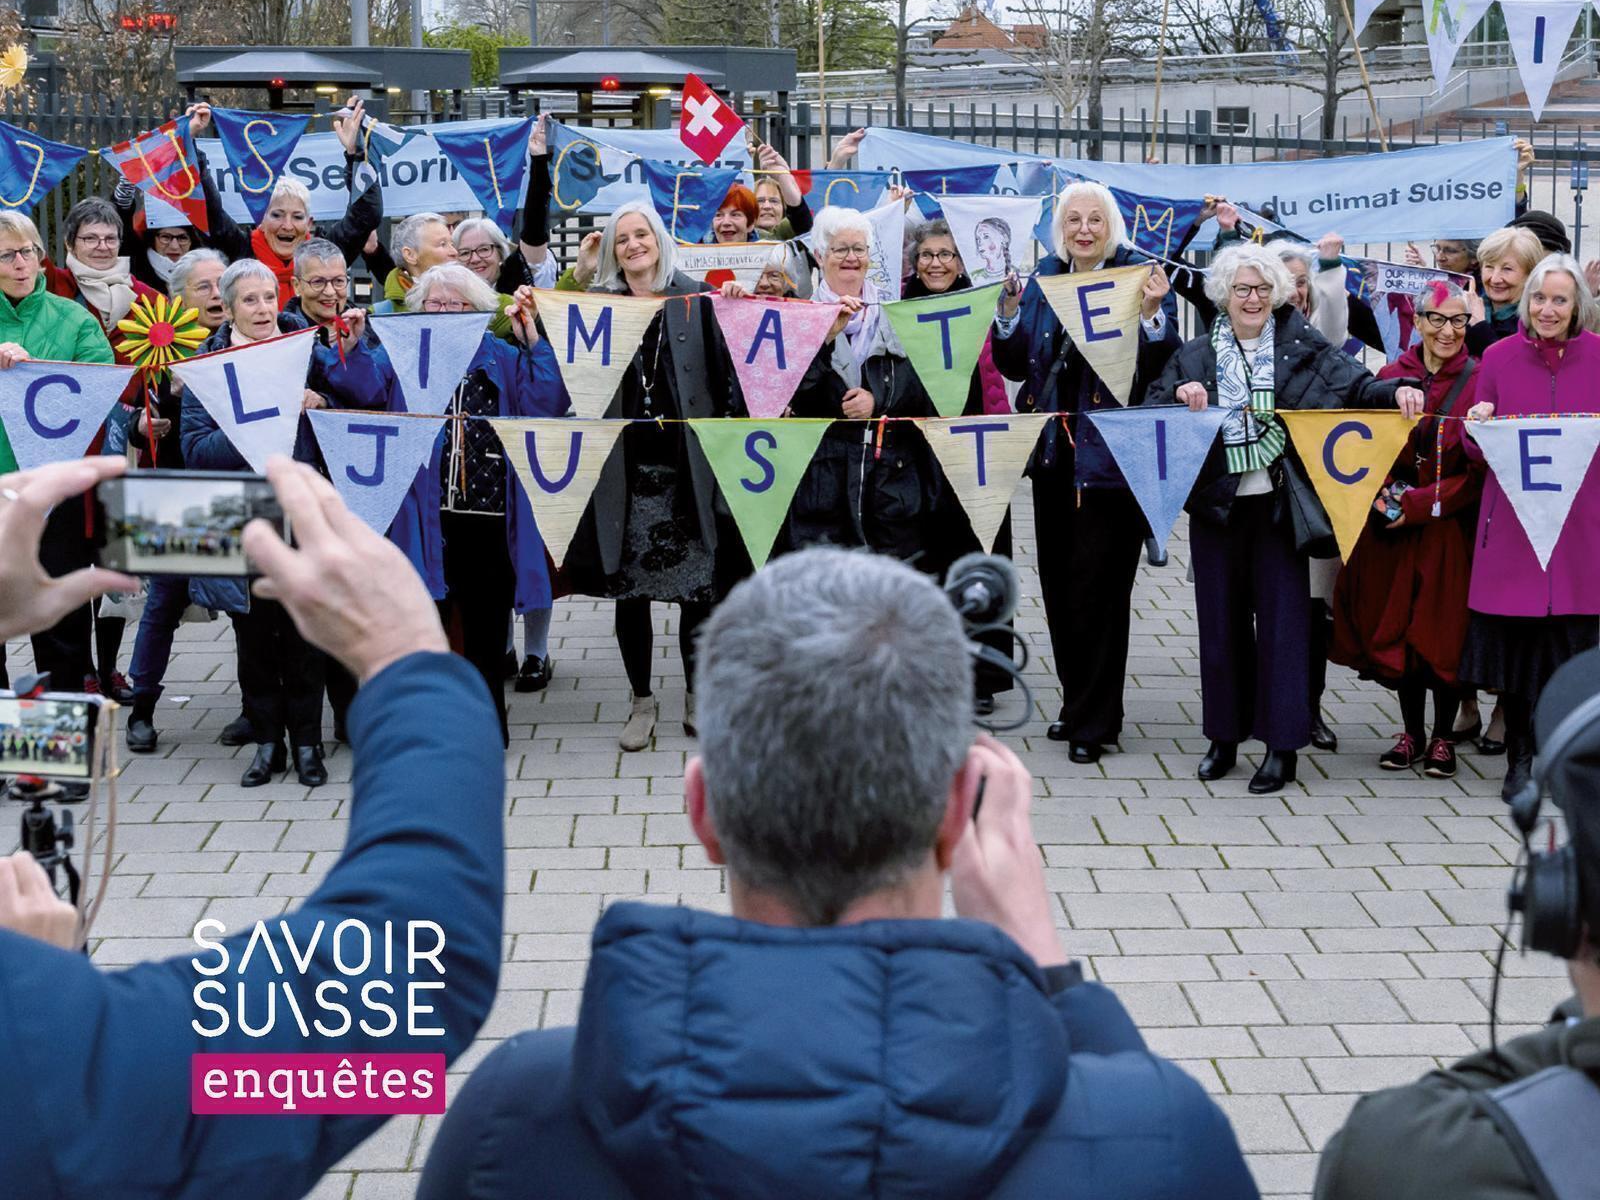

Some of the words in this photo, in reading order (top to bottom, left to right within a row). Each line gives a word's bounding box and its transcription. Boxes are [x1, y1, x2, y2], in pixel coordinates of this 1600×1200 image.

[1307, 187, 1401, 215] climat
[1407, 178, 1504, 203] Suisse
[1384, 268, 1405, 279] OUR
[1384, 279, 1405, 289] OUR
